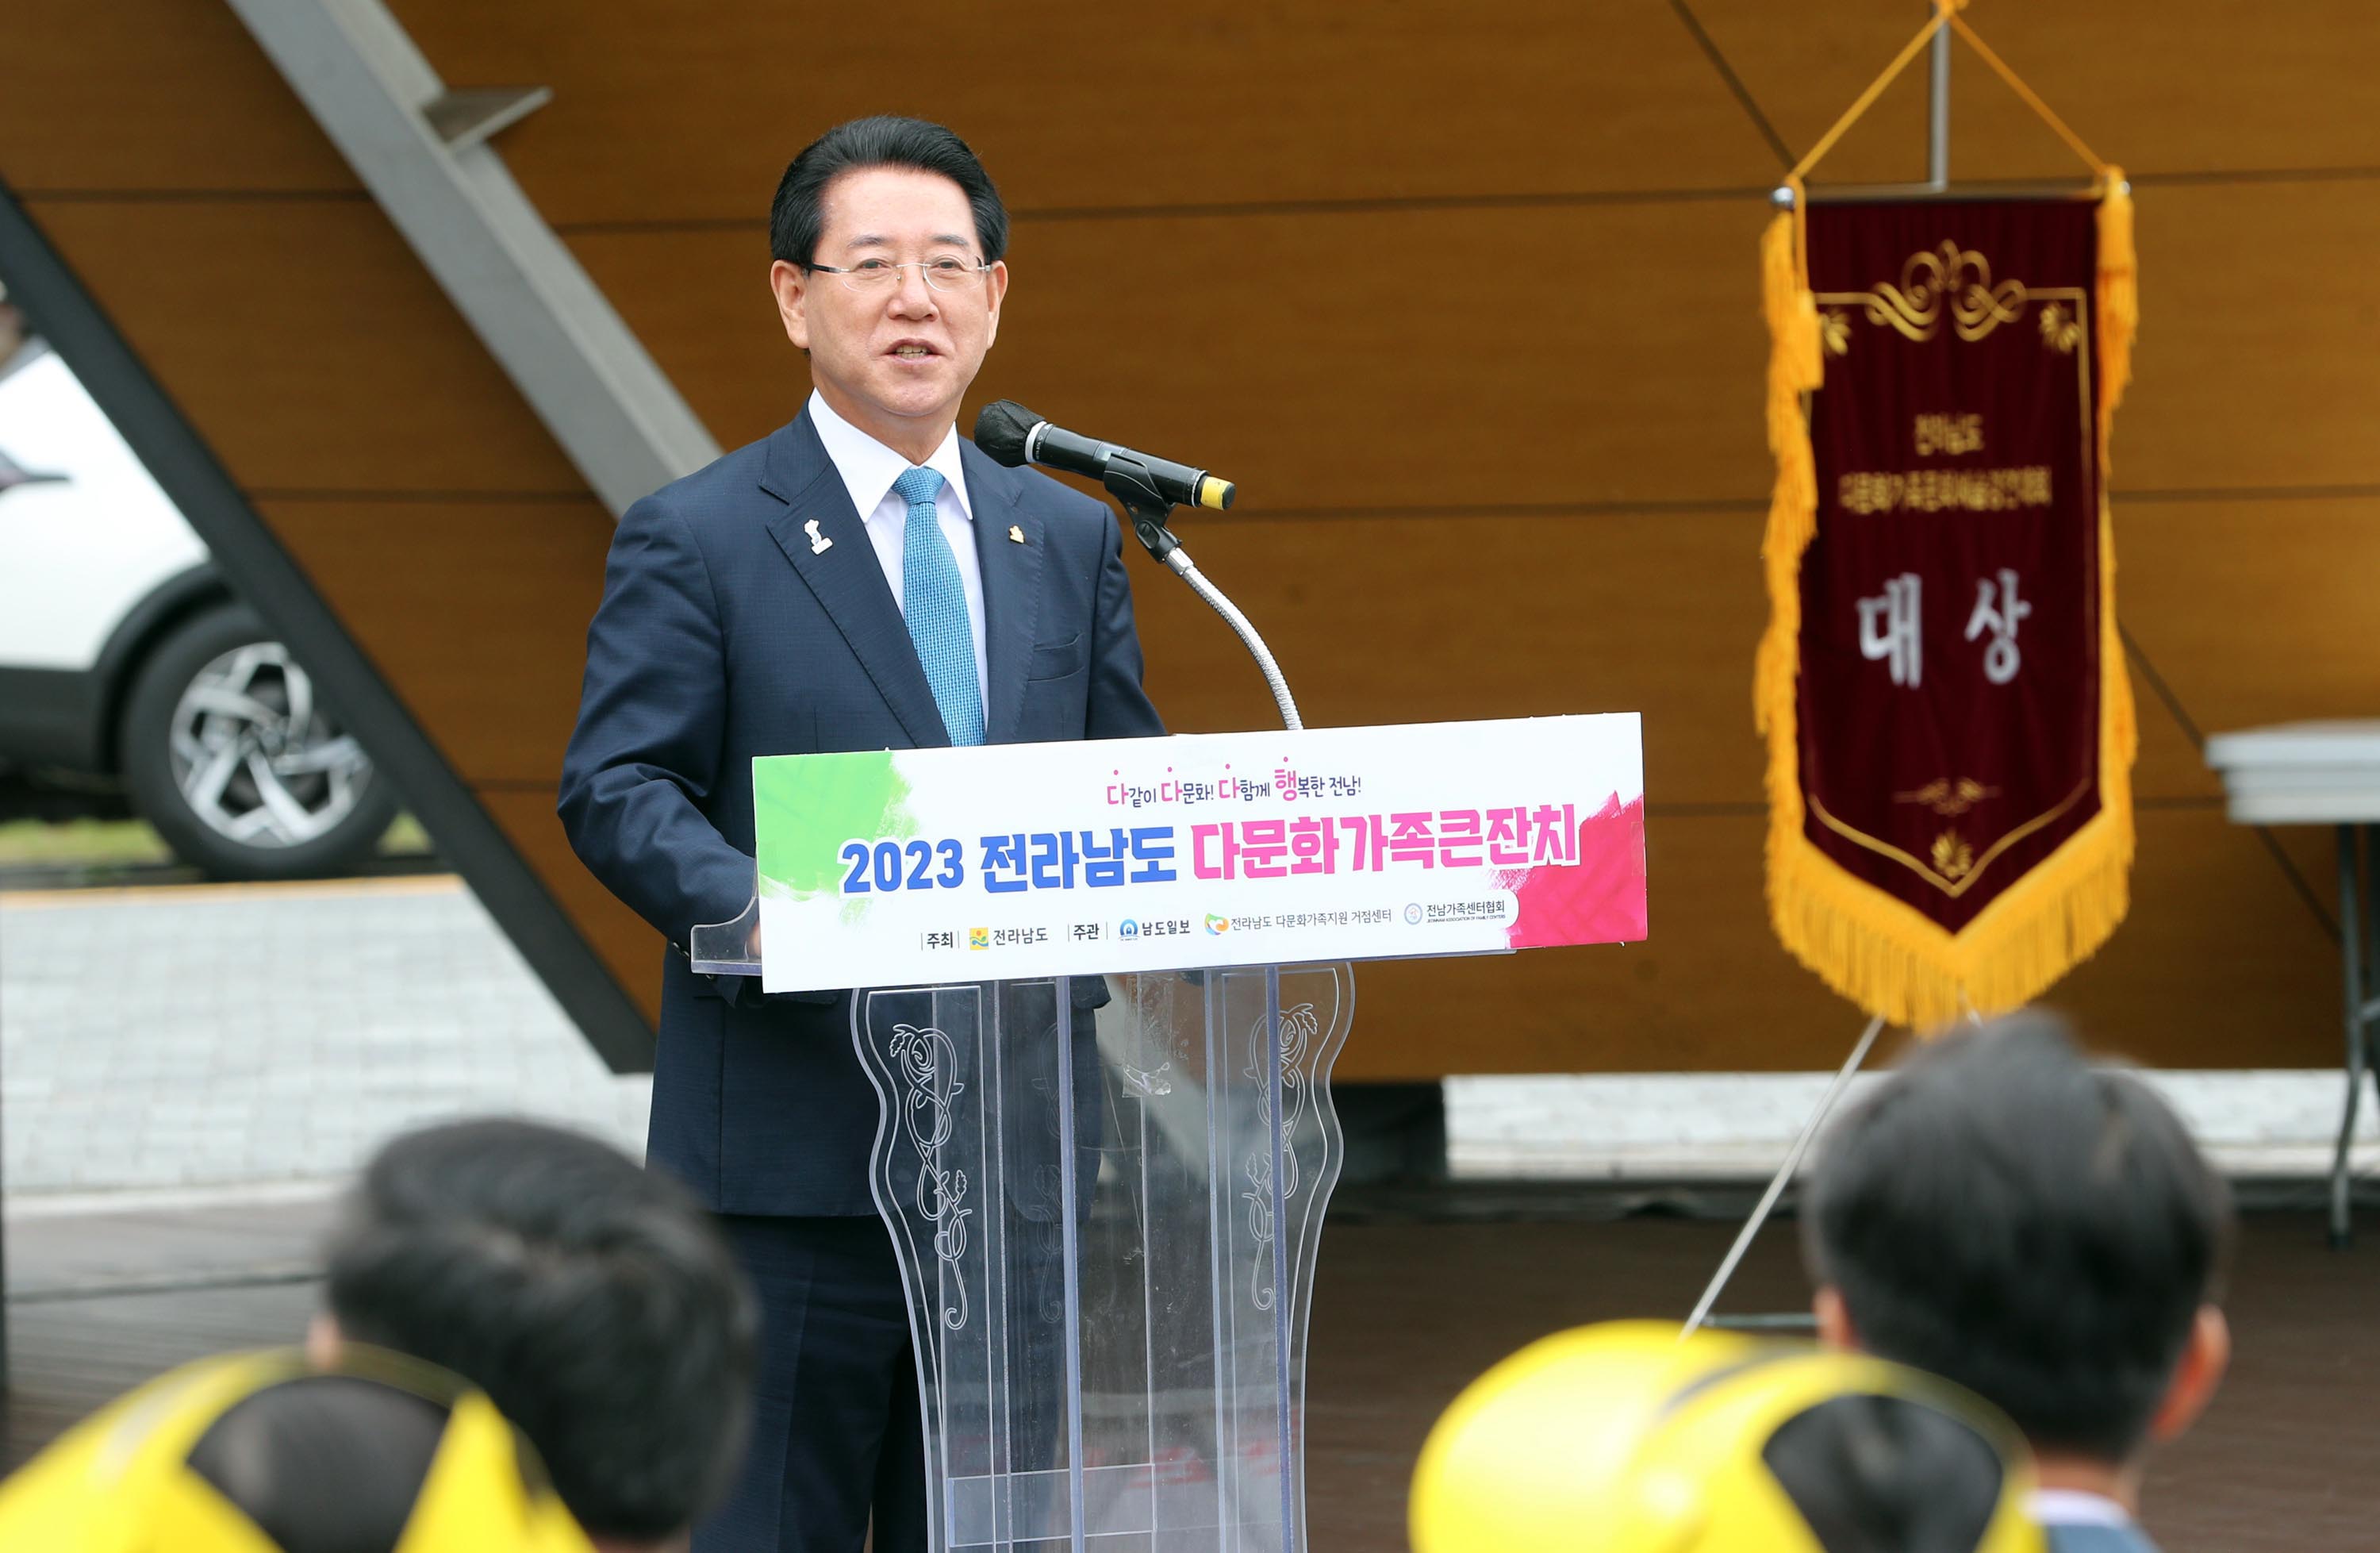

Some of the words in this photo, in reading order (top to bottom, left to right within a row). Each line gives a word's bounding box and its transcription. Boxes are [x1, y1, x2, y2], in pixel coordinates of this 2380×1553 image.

[1107, 782, 1157, 808] 다같이
[1161, 779, 1214, 805] 다문화!
[1219, 776, 1270, 801] 다함께
[1274, 768, 1325, 801] 행복한
[1329, 775, 1361, 797] 전남!
[843, 839, 964, 894] 2023
[980, 826, 1177, 894] 전라남도
[1190, 803, 1580, 881] 다문화가족큰잔치
[927, 931, 954, 949] 주최
[993, 927, 1048, 946] 전라남도
[1073, 923, 1100, 941] 주관
[1142, 919, 1191, 936] 남도일보
[1230, 915, 1273, 931] 전라남도
[1276, 911, 1348, 928] 다문화가족지원
[1351, 909, 1392, 924] 거점센터
[1426, 899, 1505, 917] 전남가족센터협회
